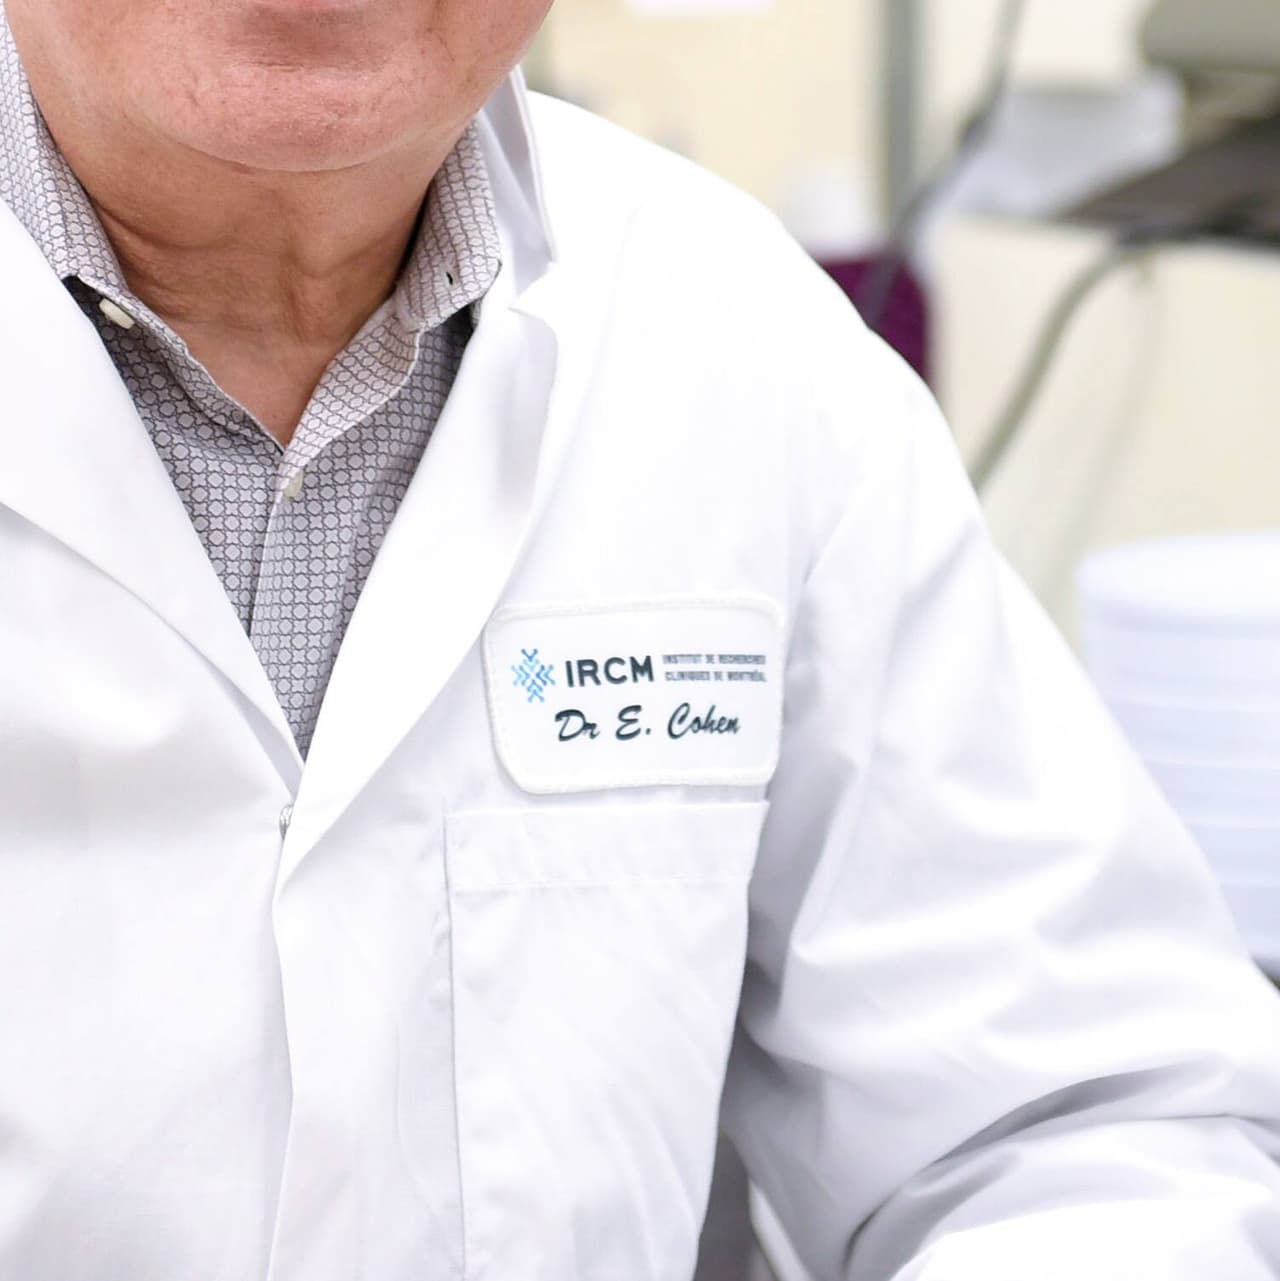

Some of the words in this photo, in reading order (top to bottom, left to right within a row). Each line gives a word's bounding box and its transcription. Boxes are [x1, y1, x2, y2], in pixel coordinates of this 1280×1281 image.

[565, 655, 654, 688] IRCM
[554, 708, 601, 742] Dr
[615, 704, 653, 741] E.
[666, 702, 741, 740] Cohen
